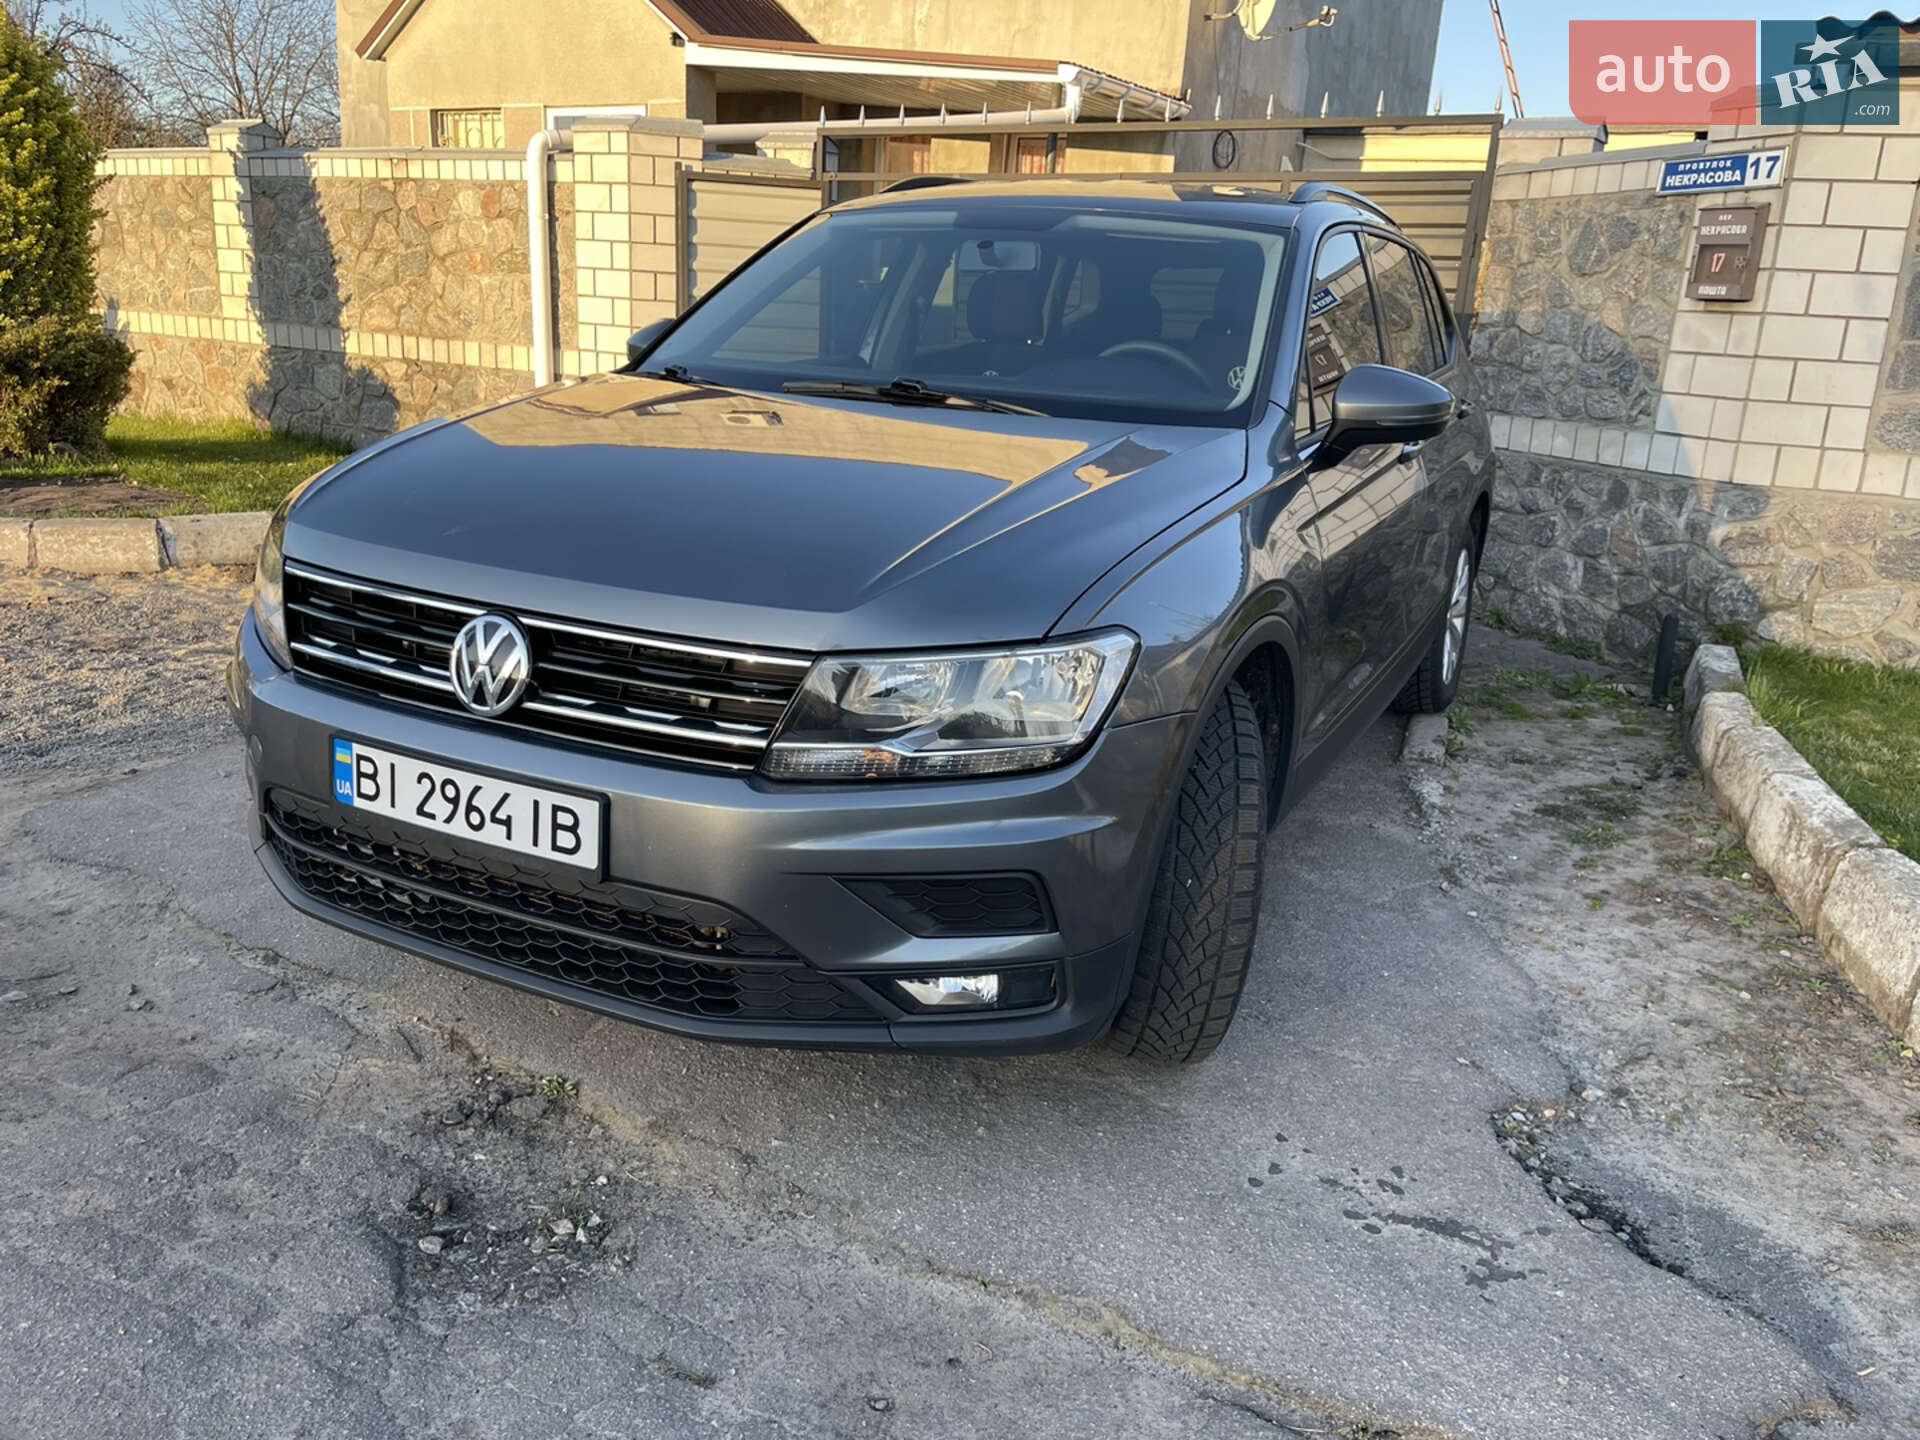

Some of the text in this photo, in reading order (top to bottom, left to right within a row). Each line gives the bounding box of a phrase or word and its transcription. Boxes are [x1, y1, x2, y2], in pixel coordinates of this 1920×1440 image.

[1677, 159, 1733, 172] ПРОВУЛОК
[1749, 155, 1780, 181] 17
[1665, 169, 1742, 187] НЕКРАСОВА
[1711, 252, 1726, 273] 17
[450, 612, 532, 716] VW
[335, 778, 352, 797] UA
[355, 752, 582, 856] BI 2964 IB
